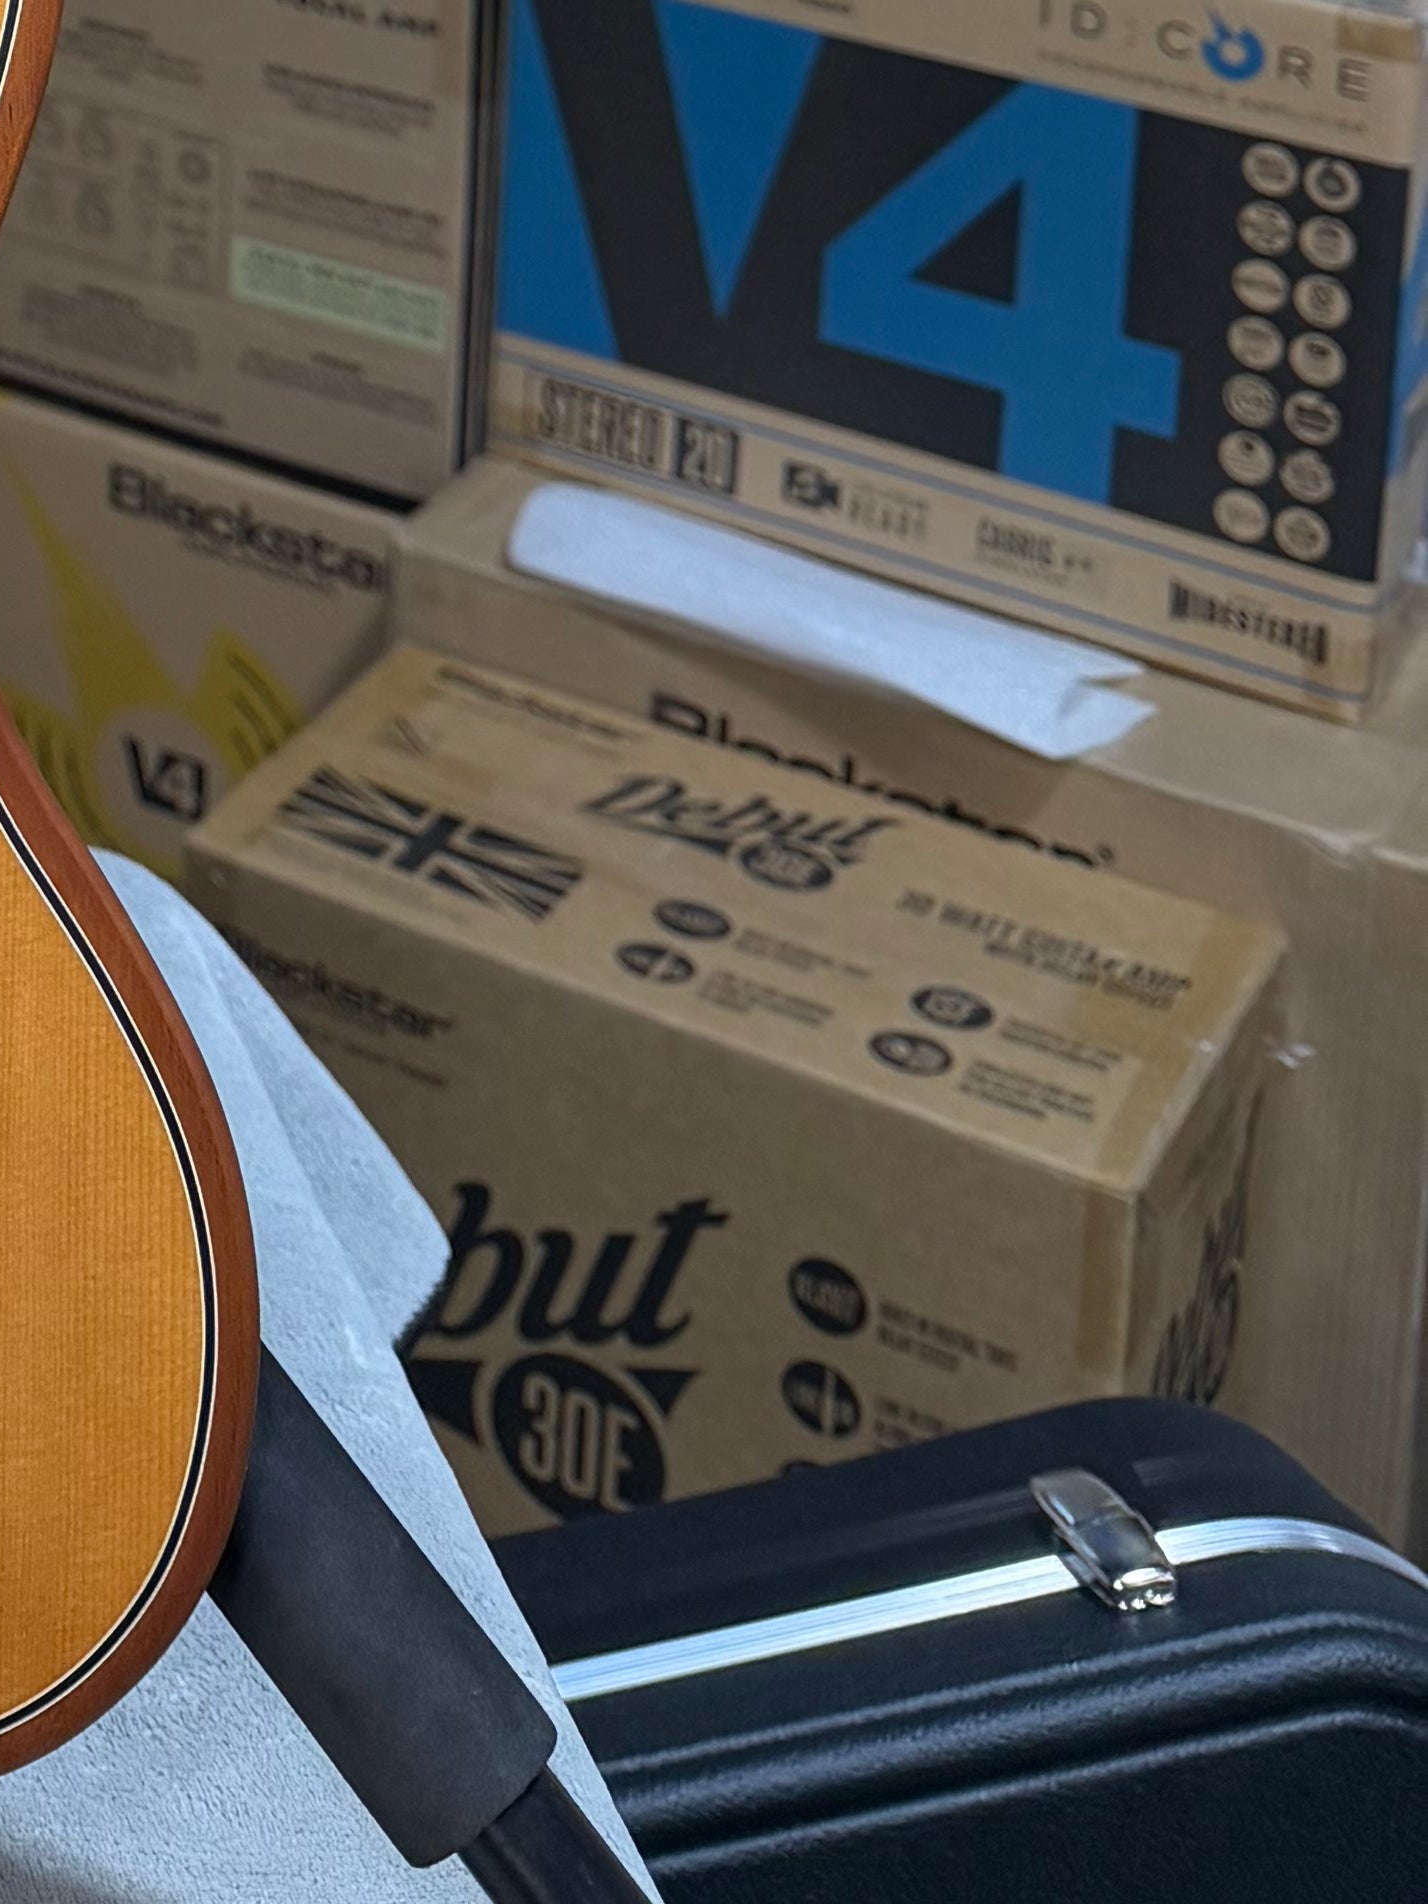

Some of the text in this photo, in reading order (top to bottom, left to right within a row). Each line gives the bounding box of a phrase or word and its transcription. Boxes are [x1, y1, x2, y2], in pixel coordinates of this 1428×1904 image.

[540, 379, 670, 472] STEREO
[576, 773, 901, 850] Debut
[406, 1182, 730, 1348] but
[516, 1369, 642, 1515] 30E
